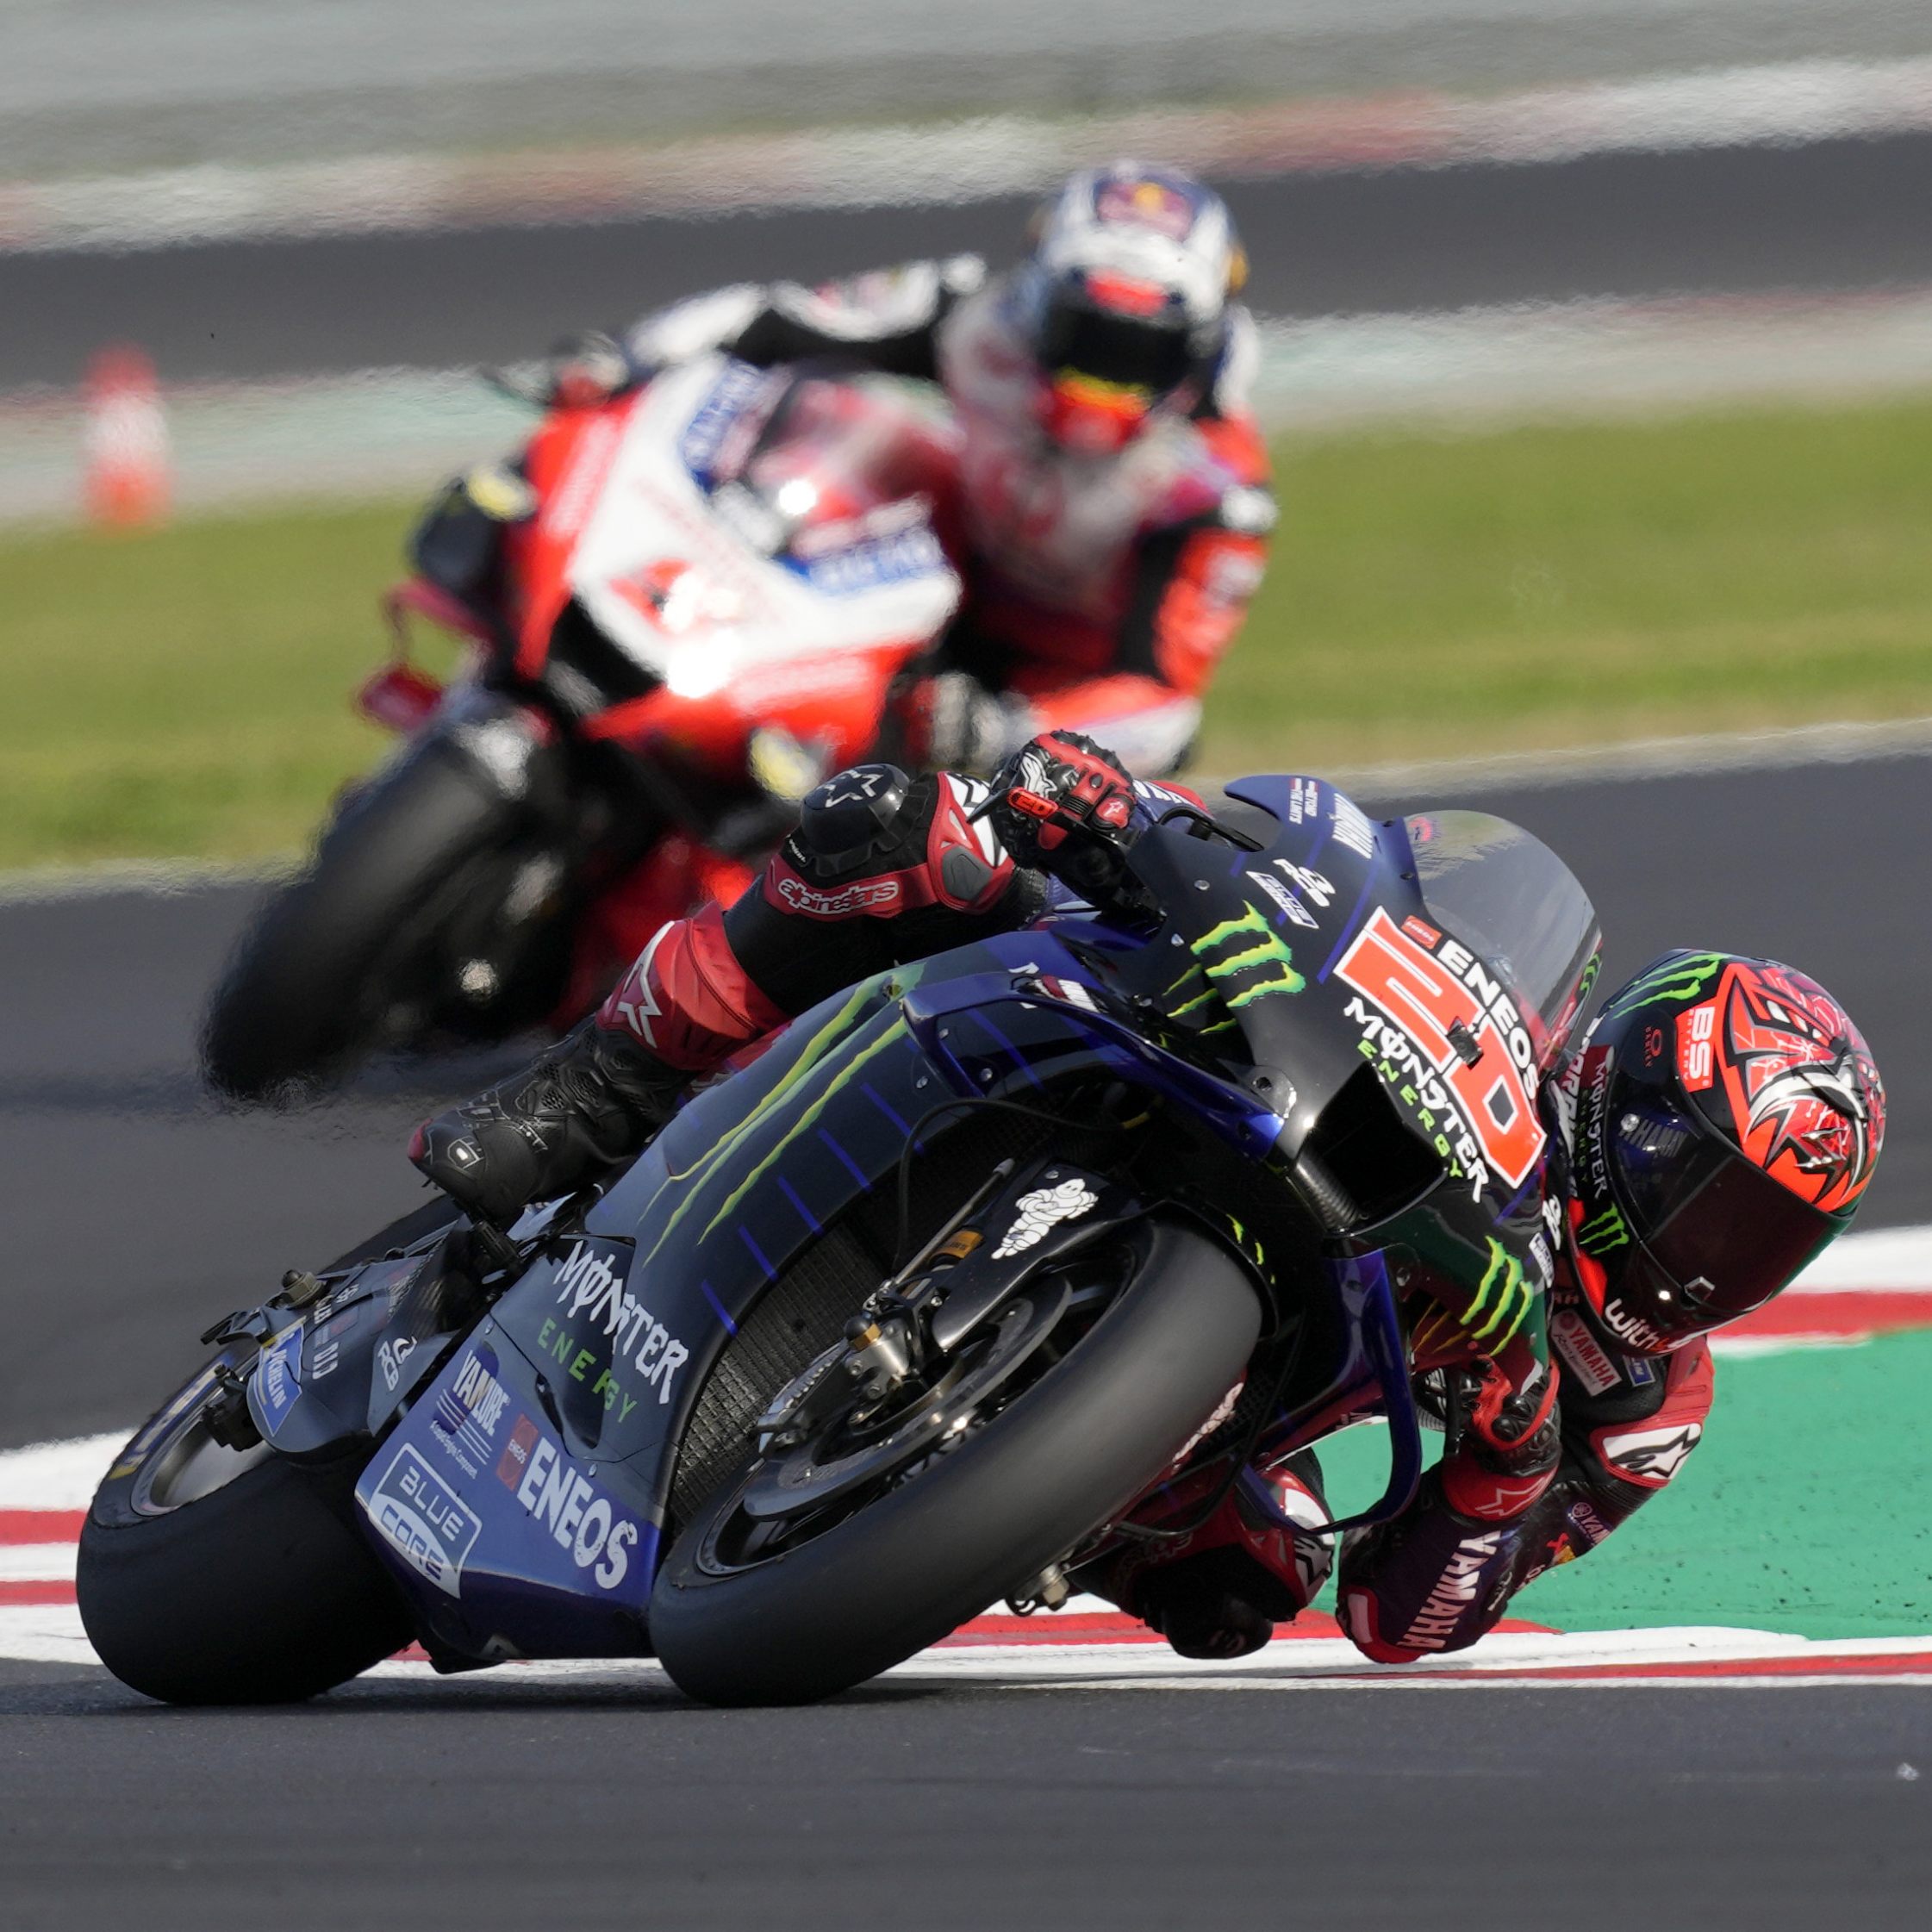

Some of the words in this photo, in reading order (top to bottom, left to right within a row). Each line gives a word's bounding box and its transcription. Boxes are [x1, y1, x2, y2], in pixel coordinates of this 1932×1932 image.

[1437, 939, 1539, 1100] ENEOS
[1689, 1006, 1715, 1080] BS
[1343, 996, 1489, 1202] MONSTER
[1357, 1038, 1463, 1178] ENERGY
[1586, 1061, 1610, 1200] MONSTER
[536, 1318, 639, 1424] ENERGY
[1568, 1326, 1621, 1388] YAMAHA
[380, 1502, 443, 1581] CORE
[398, 1465, 467, 1542] BLUE
[517, 1437, 638, 1590] ENEOS
[1397, 1530, 1505, 1650] YAMAHA
